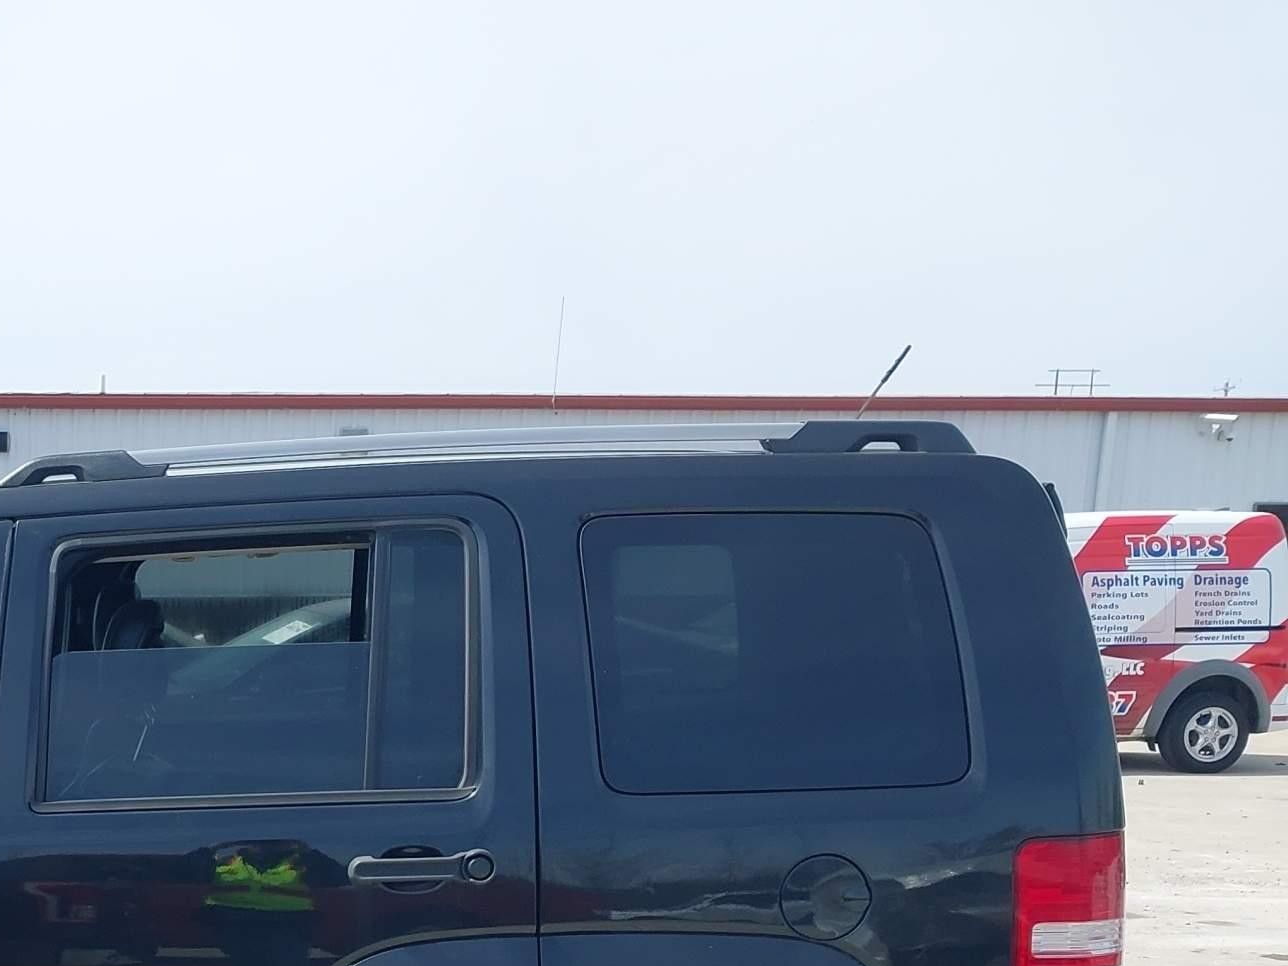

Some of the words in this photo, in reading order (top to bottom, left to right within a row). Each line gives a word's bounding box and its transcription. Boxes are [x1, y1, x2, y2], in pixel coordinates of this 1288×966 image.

[1125, 533, 1226, 558] TOPPS
[1091, 575, 1140, 590] Asphalt
[1143, 574, 1185, 590] Paving
[1194, 573, 1249, 588] Drainage
[1091, 591, 1128, 600] Parking
[1091, 602, 1120, 610] Roads
[1091, 613, 1145, 621] Sealcoating
[1194, 609, 1213, 617] Yard
[1114, 635, 1148, 643] Milling
[1222, 633, 1245, 641] Inlets
[1121, 662, 1145, 676] LLC
